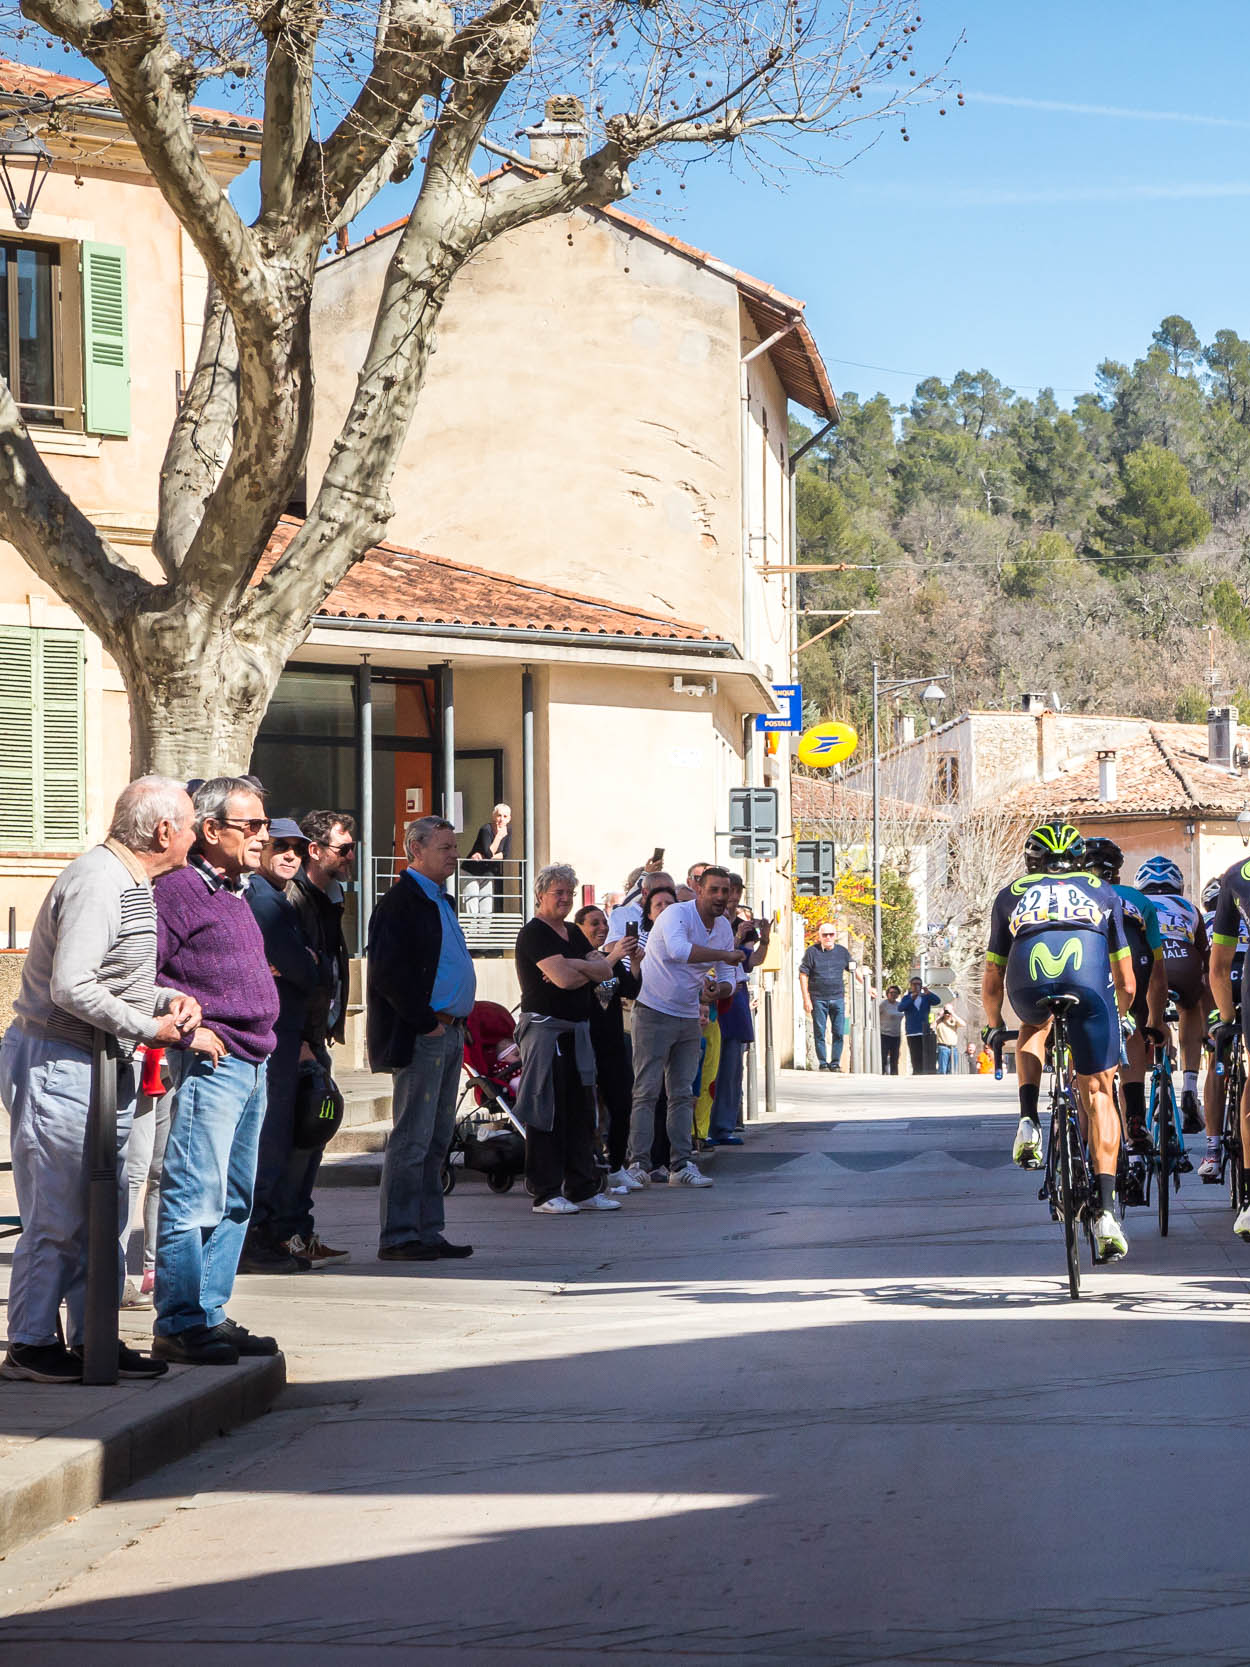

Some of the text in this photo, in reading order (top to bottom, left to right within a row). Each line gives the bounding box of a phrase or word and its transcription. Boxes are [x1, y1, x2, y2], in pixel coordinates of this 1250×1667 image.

[1016, 889, 1042, 916] 82
[1063, 906, 1096, 923] LCL
[1165, 940, 1180, 949] LA
